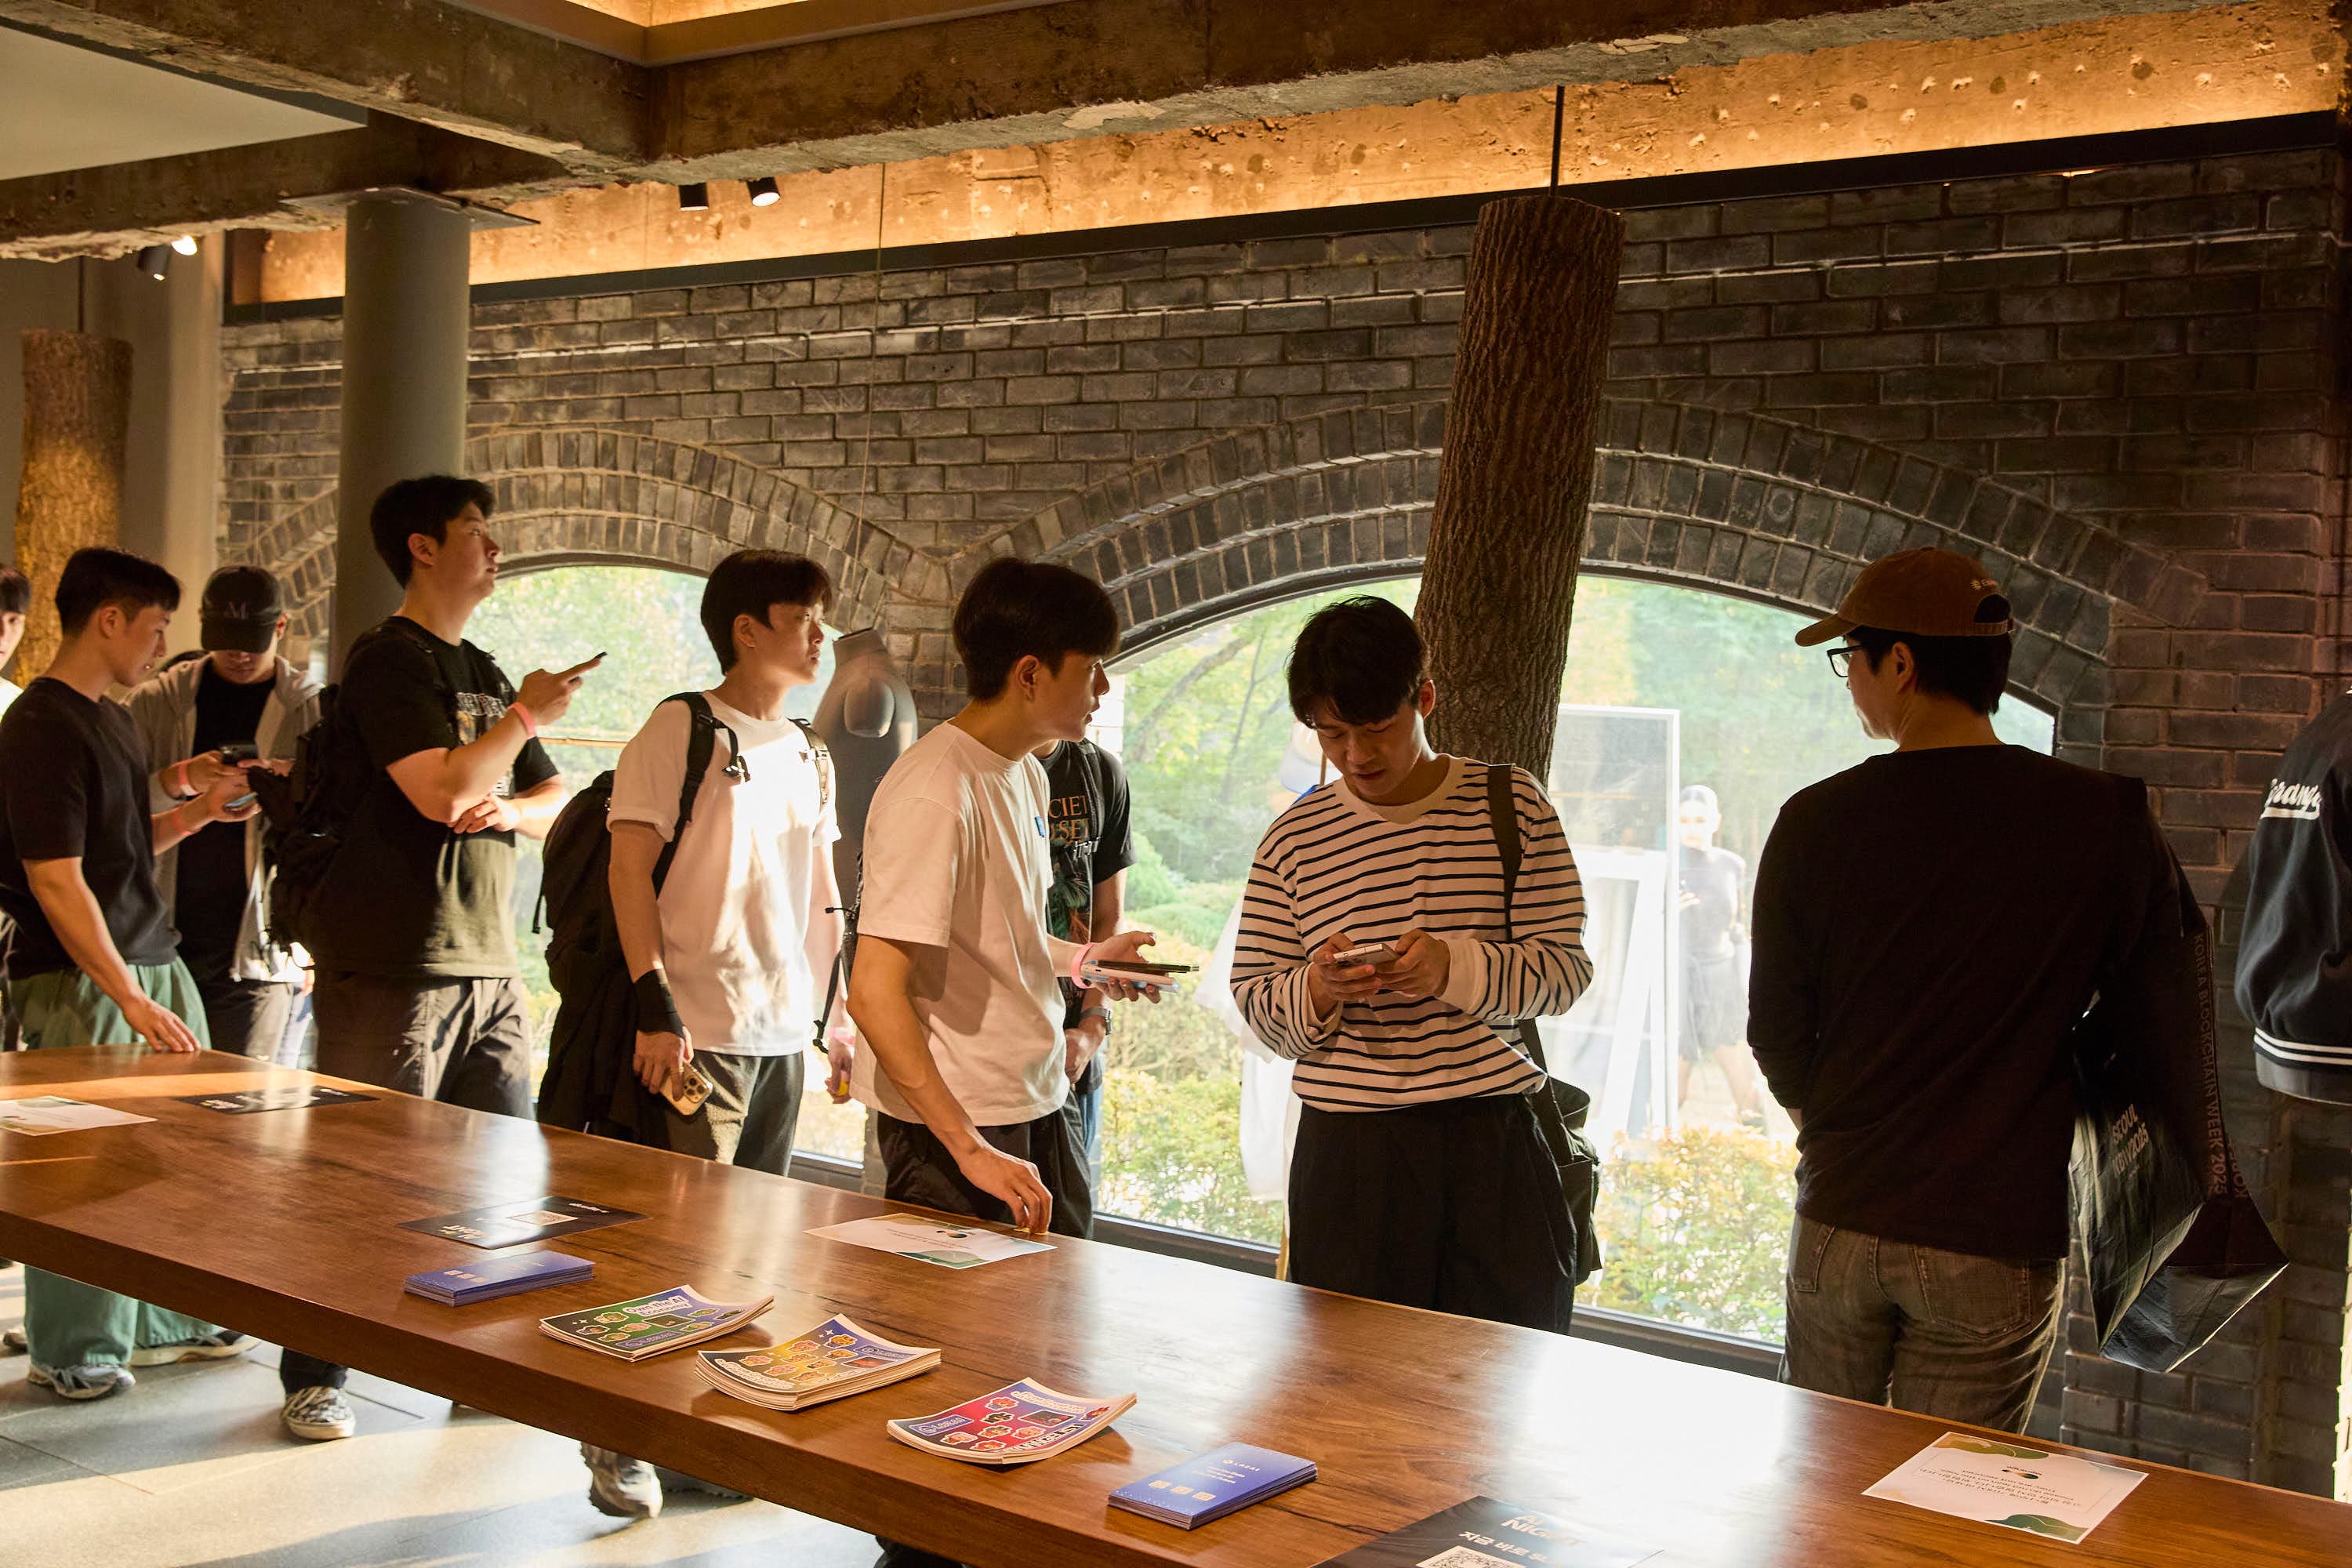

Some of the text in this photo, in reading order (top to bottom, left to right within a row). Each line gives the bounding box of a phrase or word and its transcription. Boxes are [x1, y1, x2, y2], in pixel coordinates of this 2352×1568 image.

[1048, 795, 1088, 818] CIET
[2197, 989, 2218, 1098] BLOCKCHAIN
[2207, 1099, 2225, 1149] WEEK
[2210, 1152, 2228, 1196] 2025
[626, 1305, 653, 1313] Own
[1458, 1530, 1530, 1556] 지금 바로
